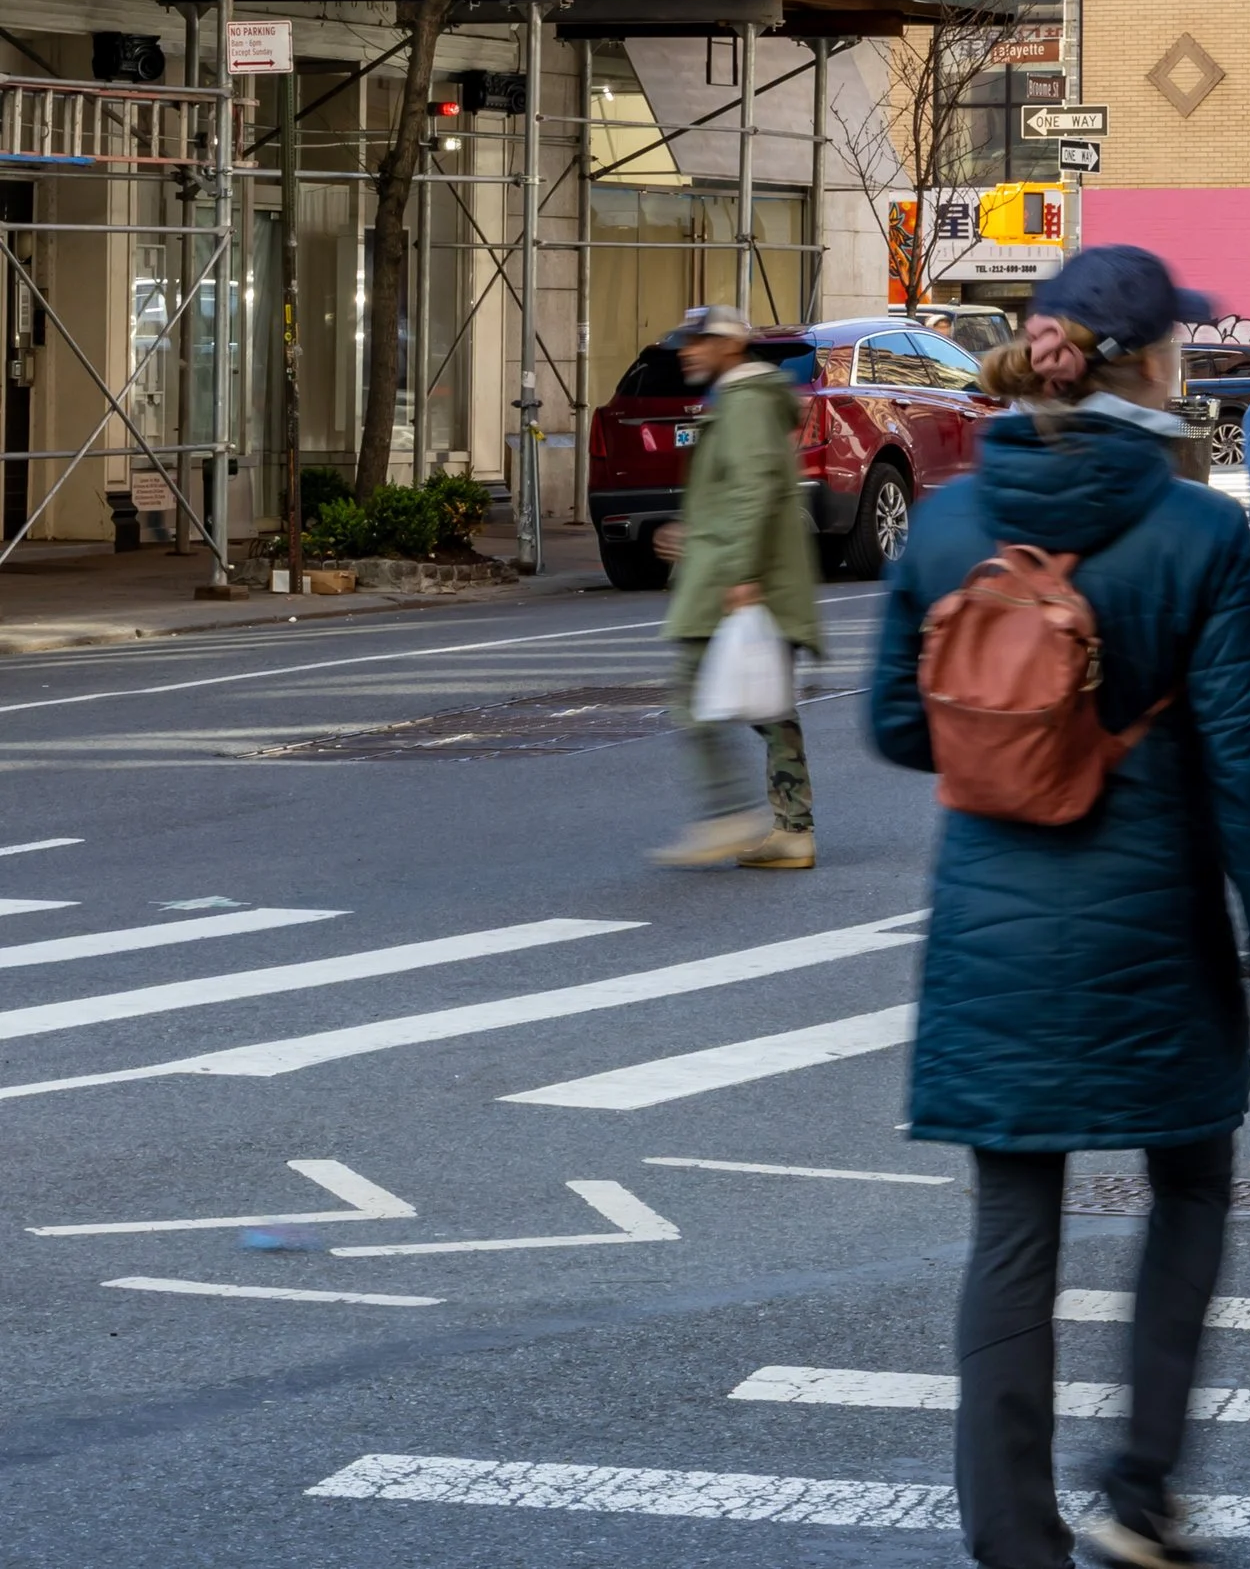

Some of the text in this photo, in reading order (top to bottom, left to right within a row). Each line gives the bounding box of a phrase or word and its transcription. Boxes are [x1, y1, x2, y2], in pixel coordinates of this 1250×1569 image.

[230, 26, 276, 36] NO PARKING
[231, 47, 273, 57] Except Sunday
[1029, 80, 1060, 97] Broome St
[1036, 115, 1097, 128] ONE WAY
[1064, 149, 1093, 163] ONE WAY
